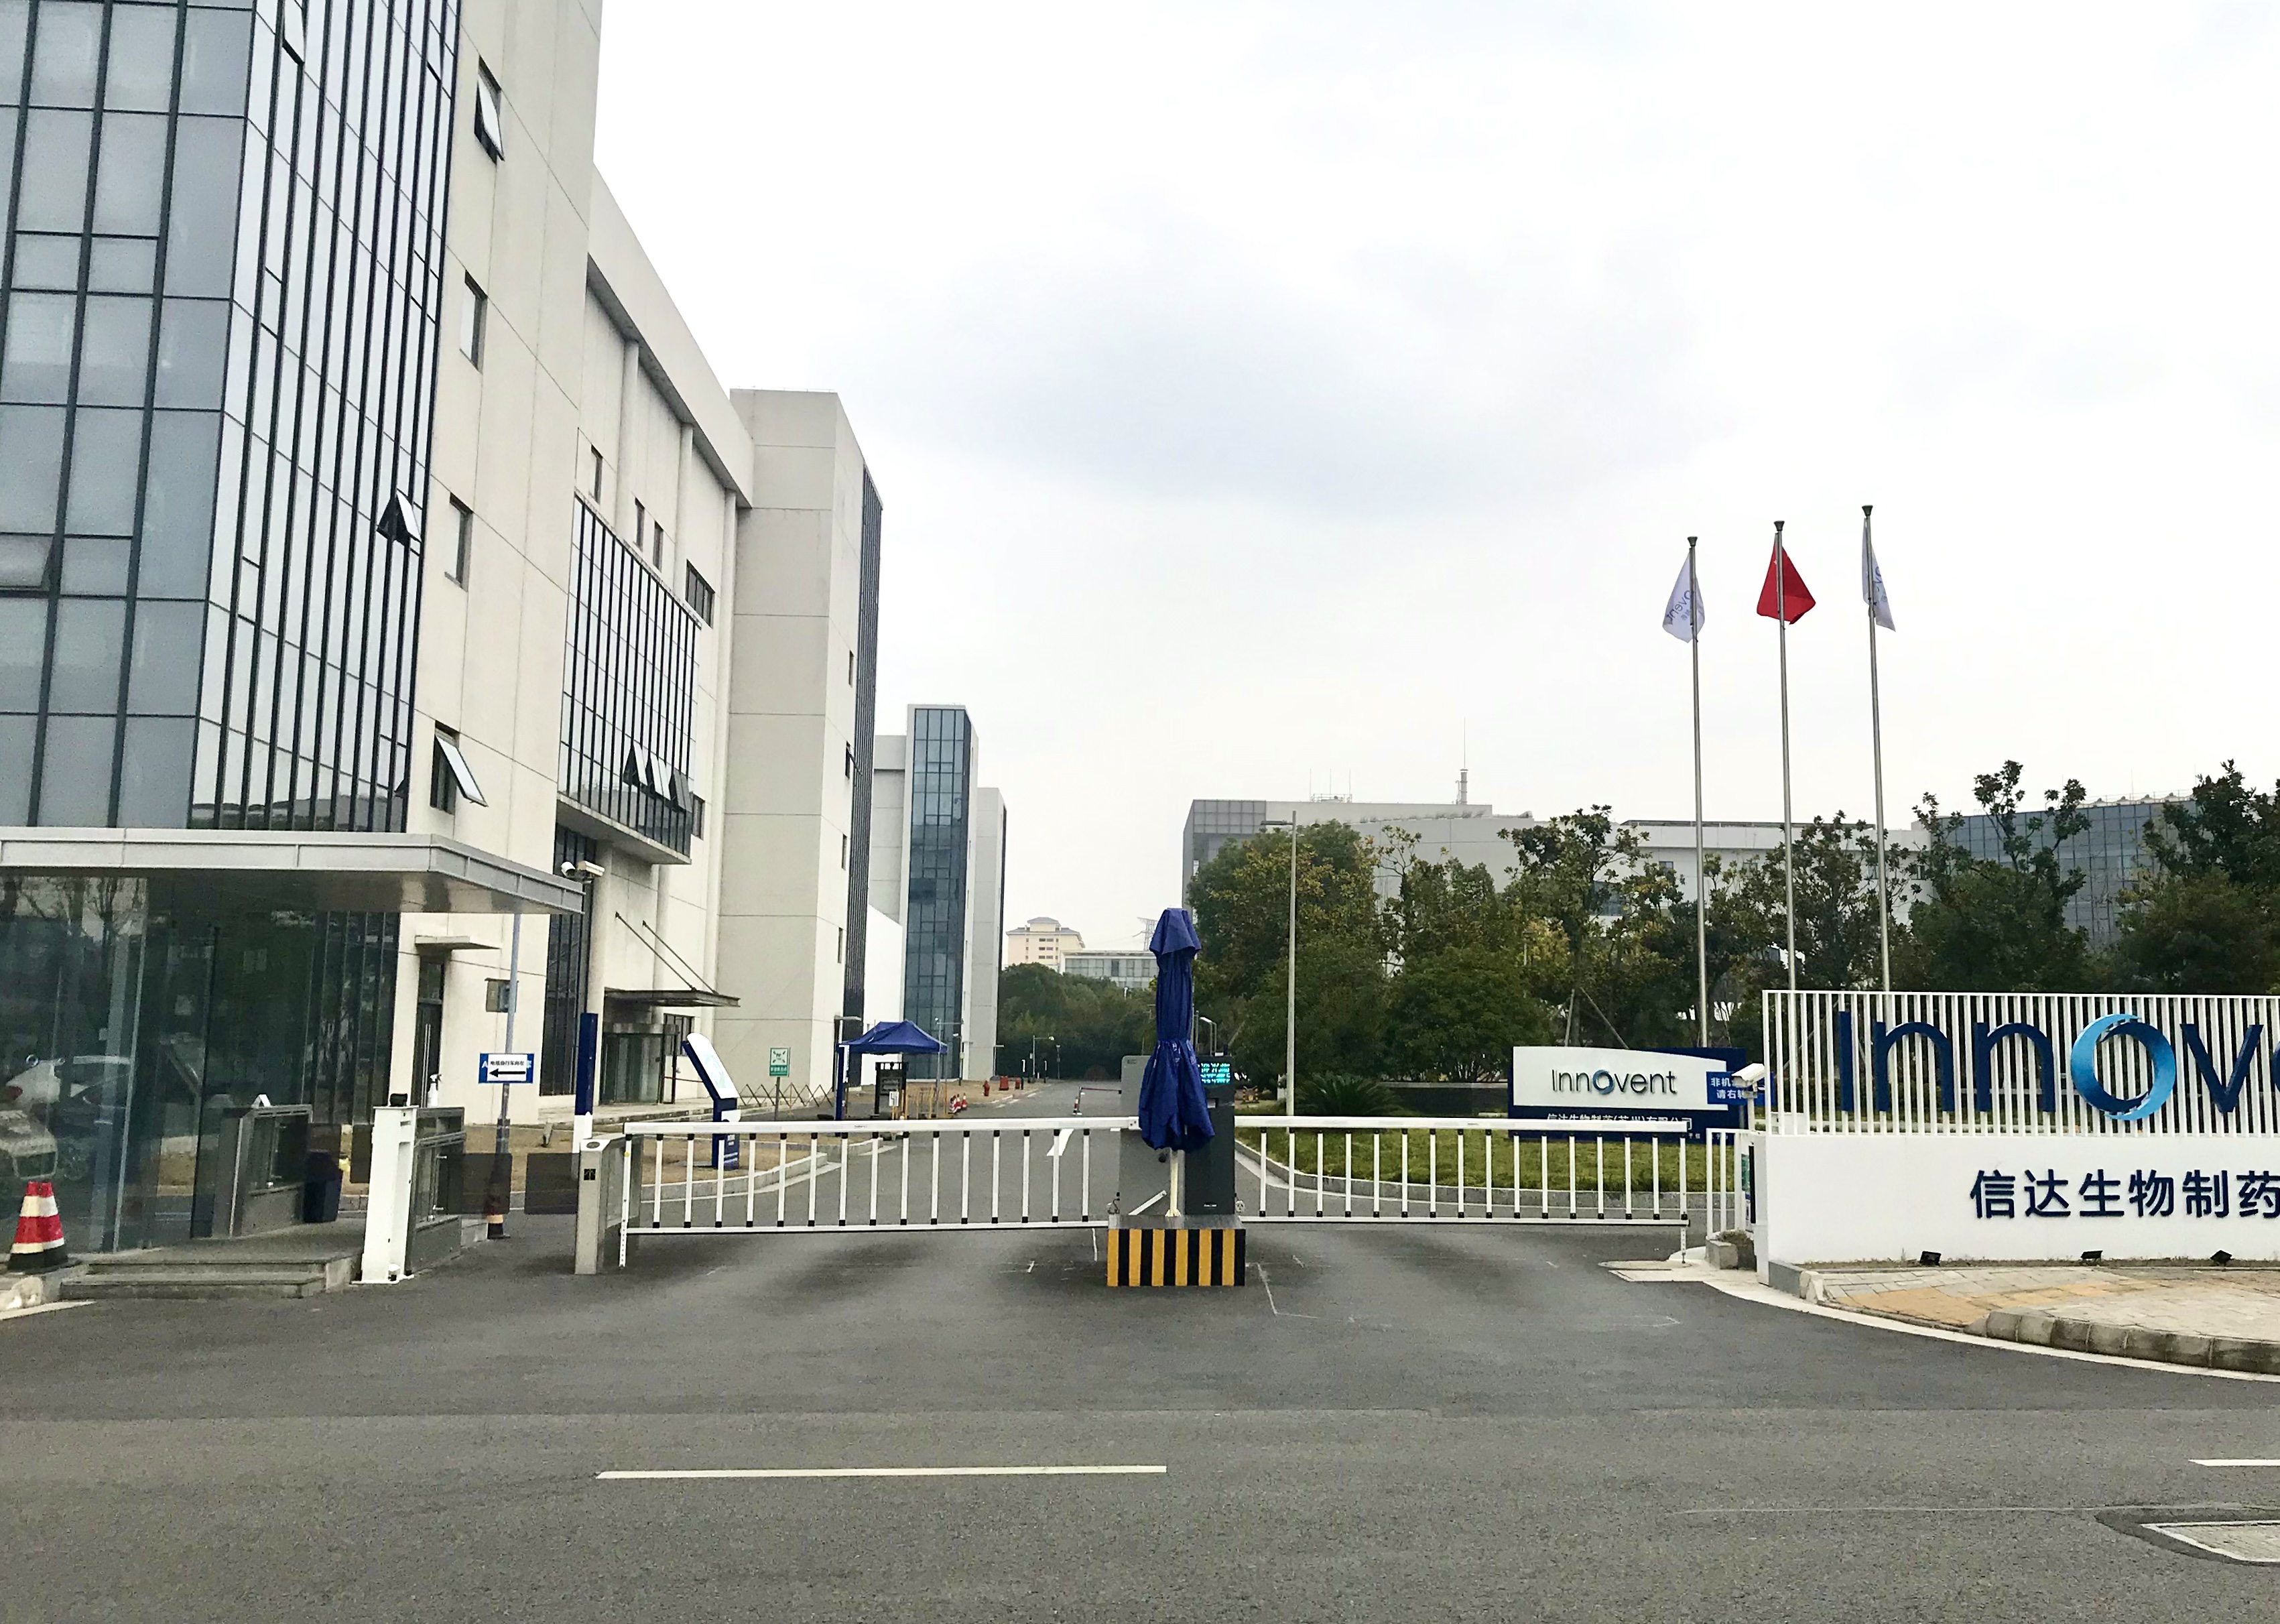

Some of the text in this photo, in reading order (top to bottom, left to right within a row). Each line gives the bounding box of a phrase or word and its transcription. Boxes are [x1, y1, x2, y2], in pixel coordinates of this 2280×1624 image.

[1551, 1069, 1677, 1095] Innovent
[1838, 1011, 2280, 1121] Innov
[1969, 1169, 2280, 1219] 信达生物制药
